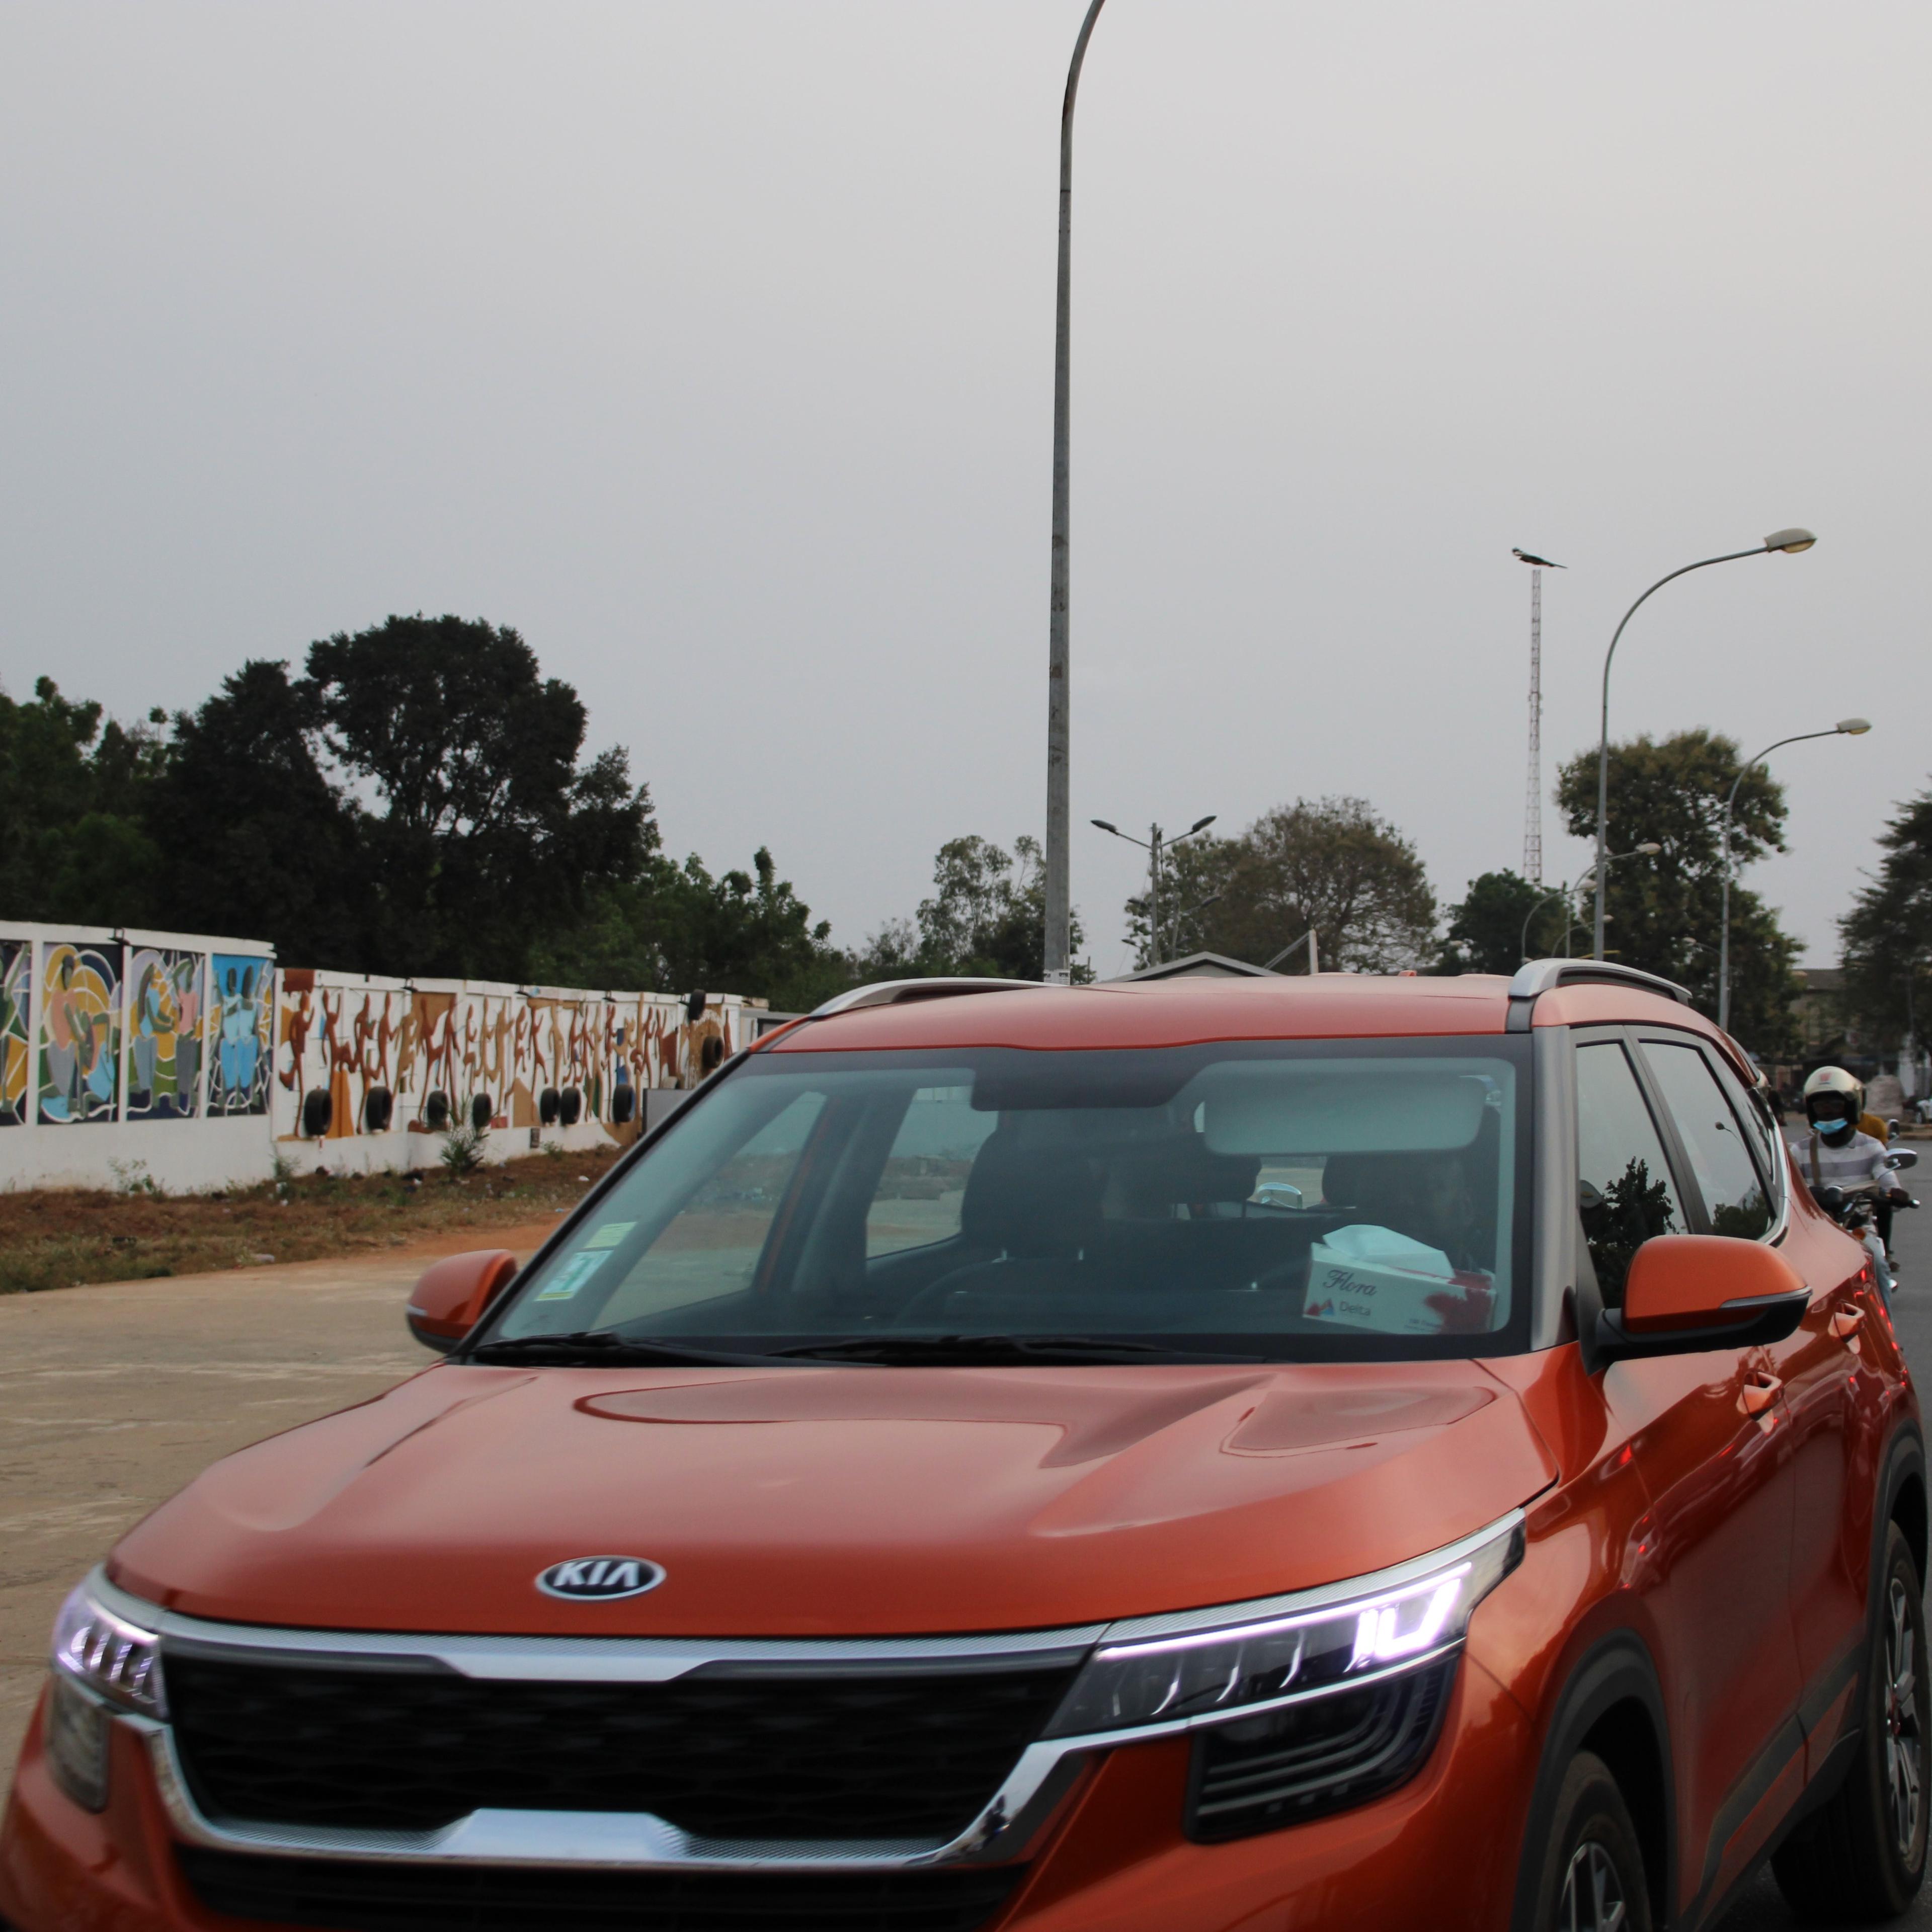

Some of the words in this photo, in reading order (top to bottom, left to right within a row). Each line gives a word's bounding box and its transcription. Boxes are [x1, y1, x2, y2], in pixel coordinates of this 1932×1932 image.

[1323, 1269, 1378, 1296] Flora
[1339, 1301, 1372, 1316] Delta
[552, 1560, 640, 1587] KIA
